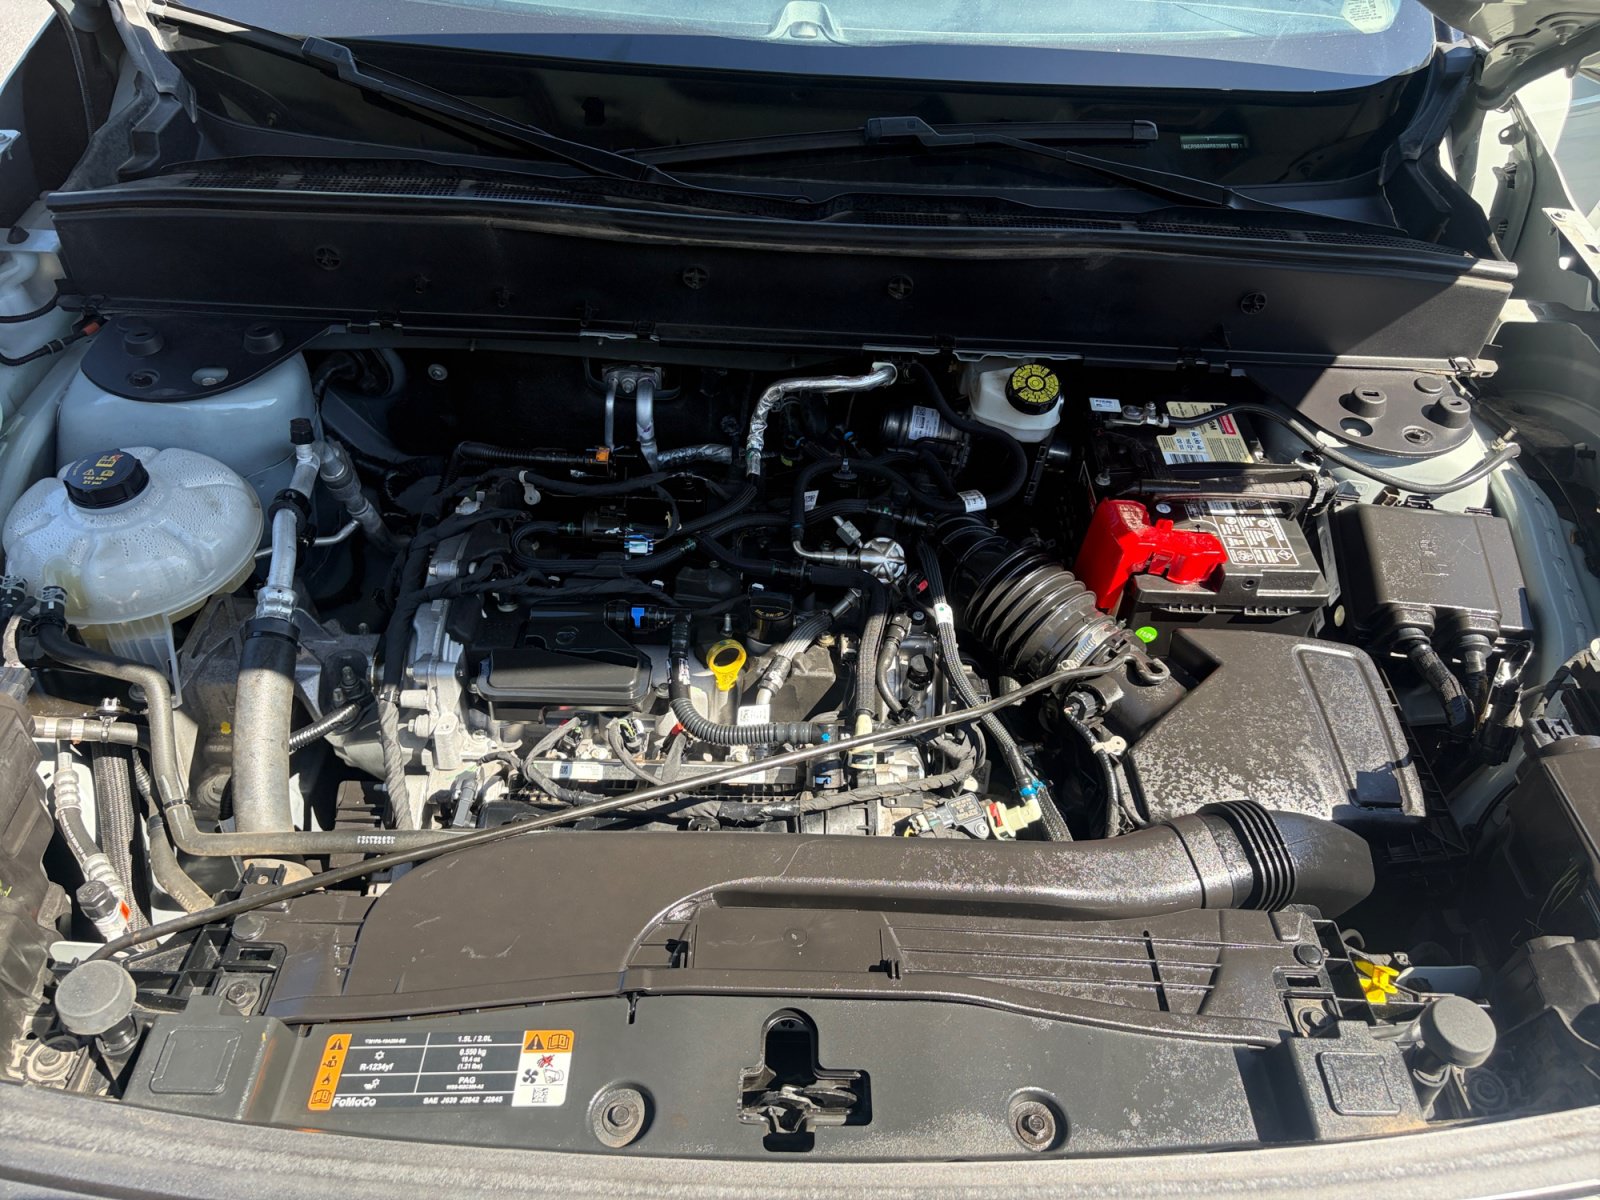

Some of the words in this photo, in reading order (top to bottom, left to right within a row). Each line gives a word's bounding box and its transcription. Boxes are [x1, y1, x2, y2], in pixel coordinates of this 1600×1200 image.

[457, 1035, 473, 1043] 1.5L
[477, 1034, 493, 1043] 2.0L
[459, 1048, 477, 1056] 0.550
[477, 1048, 487, 1057] kg
[359, 1062, 395, 1072] R-1234yf
[458, 1076, 477, 1084] PAG
[332, 1096, 377, 1107] FoMoCo
[423, 1097, 439, 1105] SAE
